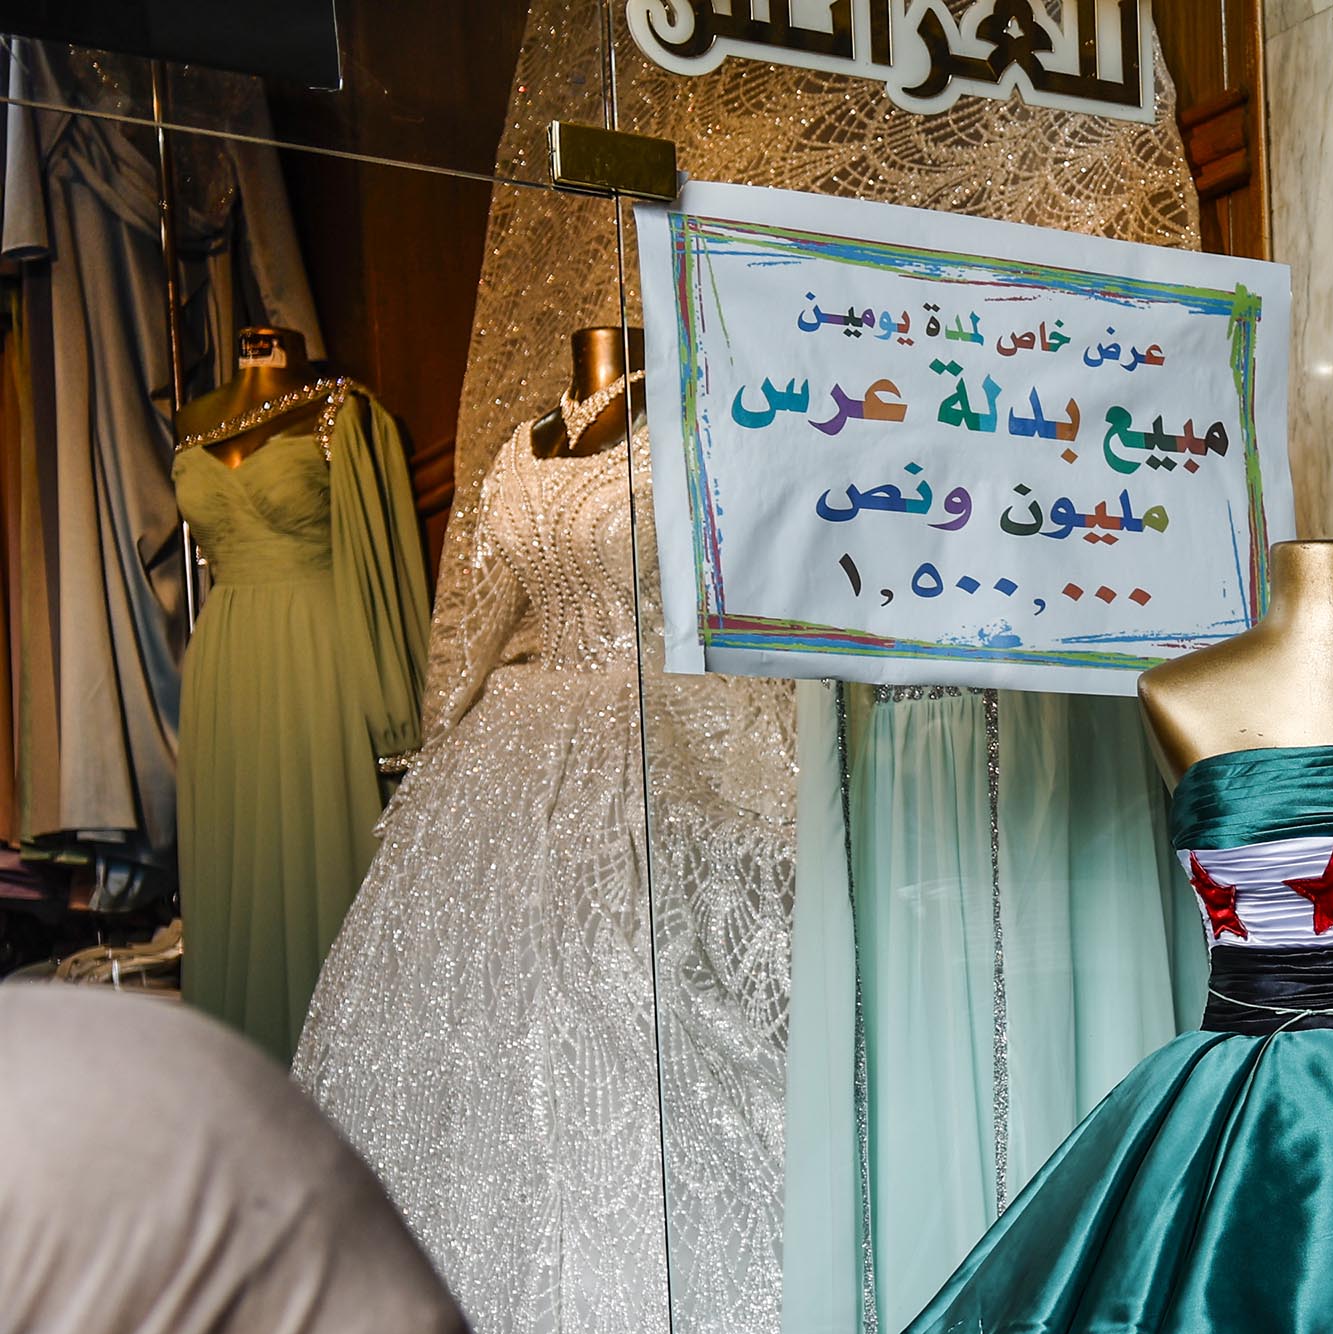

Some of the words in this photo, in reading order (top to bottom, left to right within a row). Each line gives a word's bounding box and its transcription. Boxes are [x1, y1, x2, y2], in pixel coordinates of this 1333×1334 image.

[797, 292, 914, 347] يومين
[923, 303, 985, 346] لمدة
[997, 320, 1071, 356] خاص
[1083, 326, 1165, 368] عرض
[731, 377, 908, 436] عرس
[935, 358, 1081, 464] بدلة
[1103, 405, 1229, 474] مبيع
[815, 461, 974, 530] ونص
[1000, 484, 1169, 545] مليون
